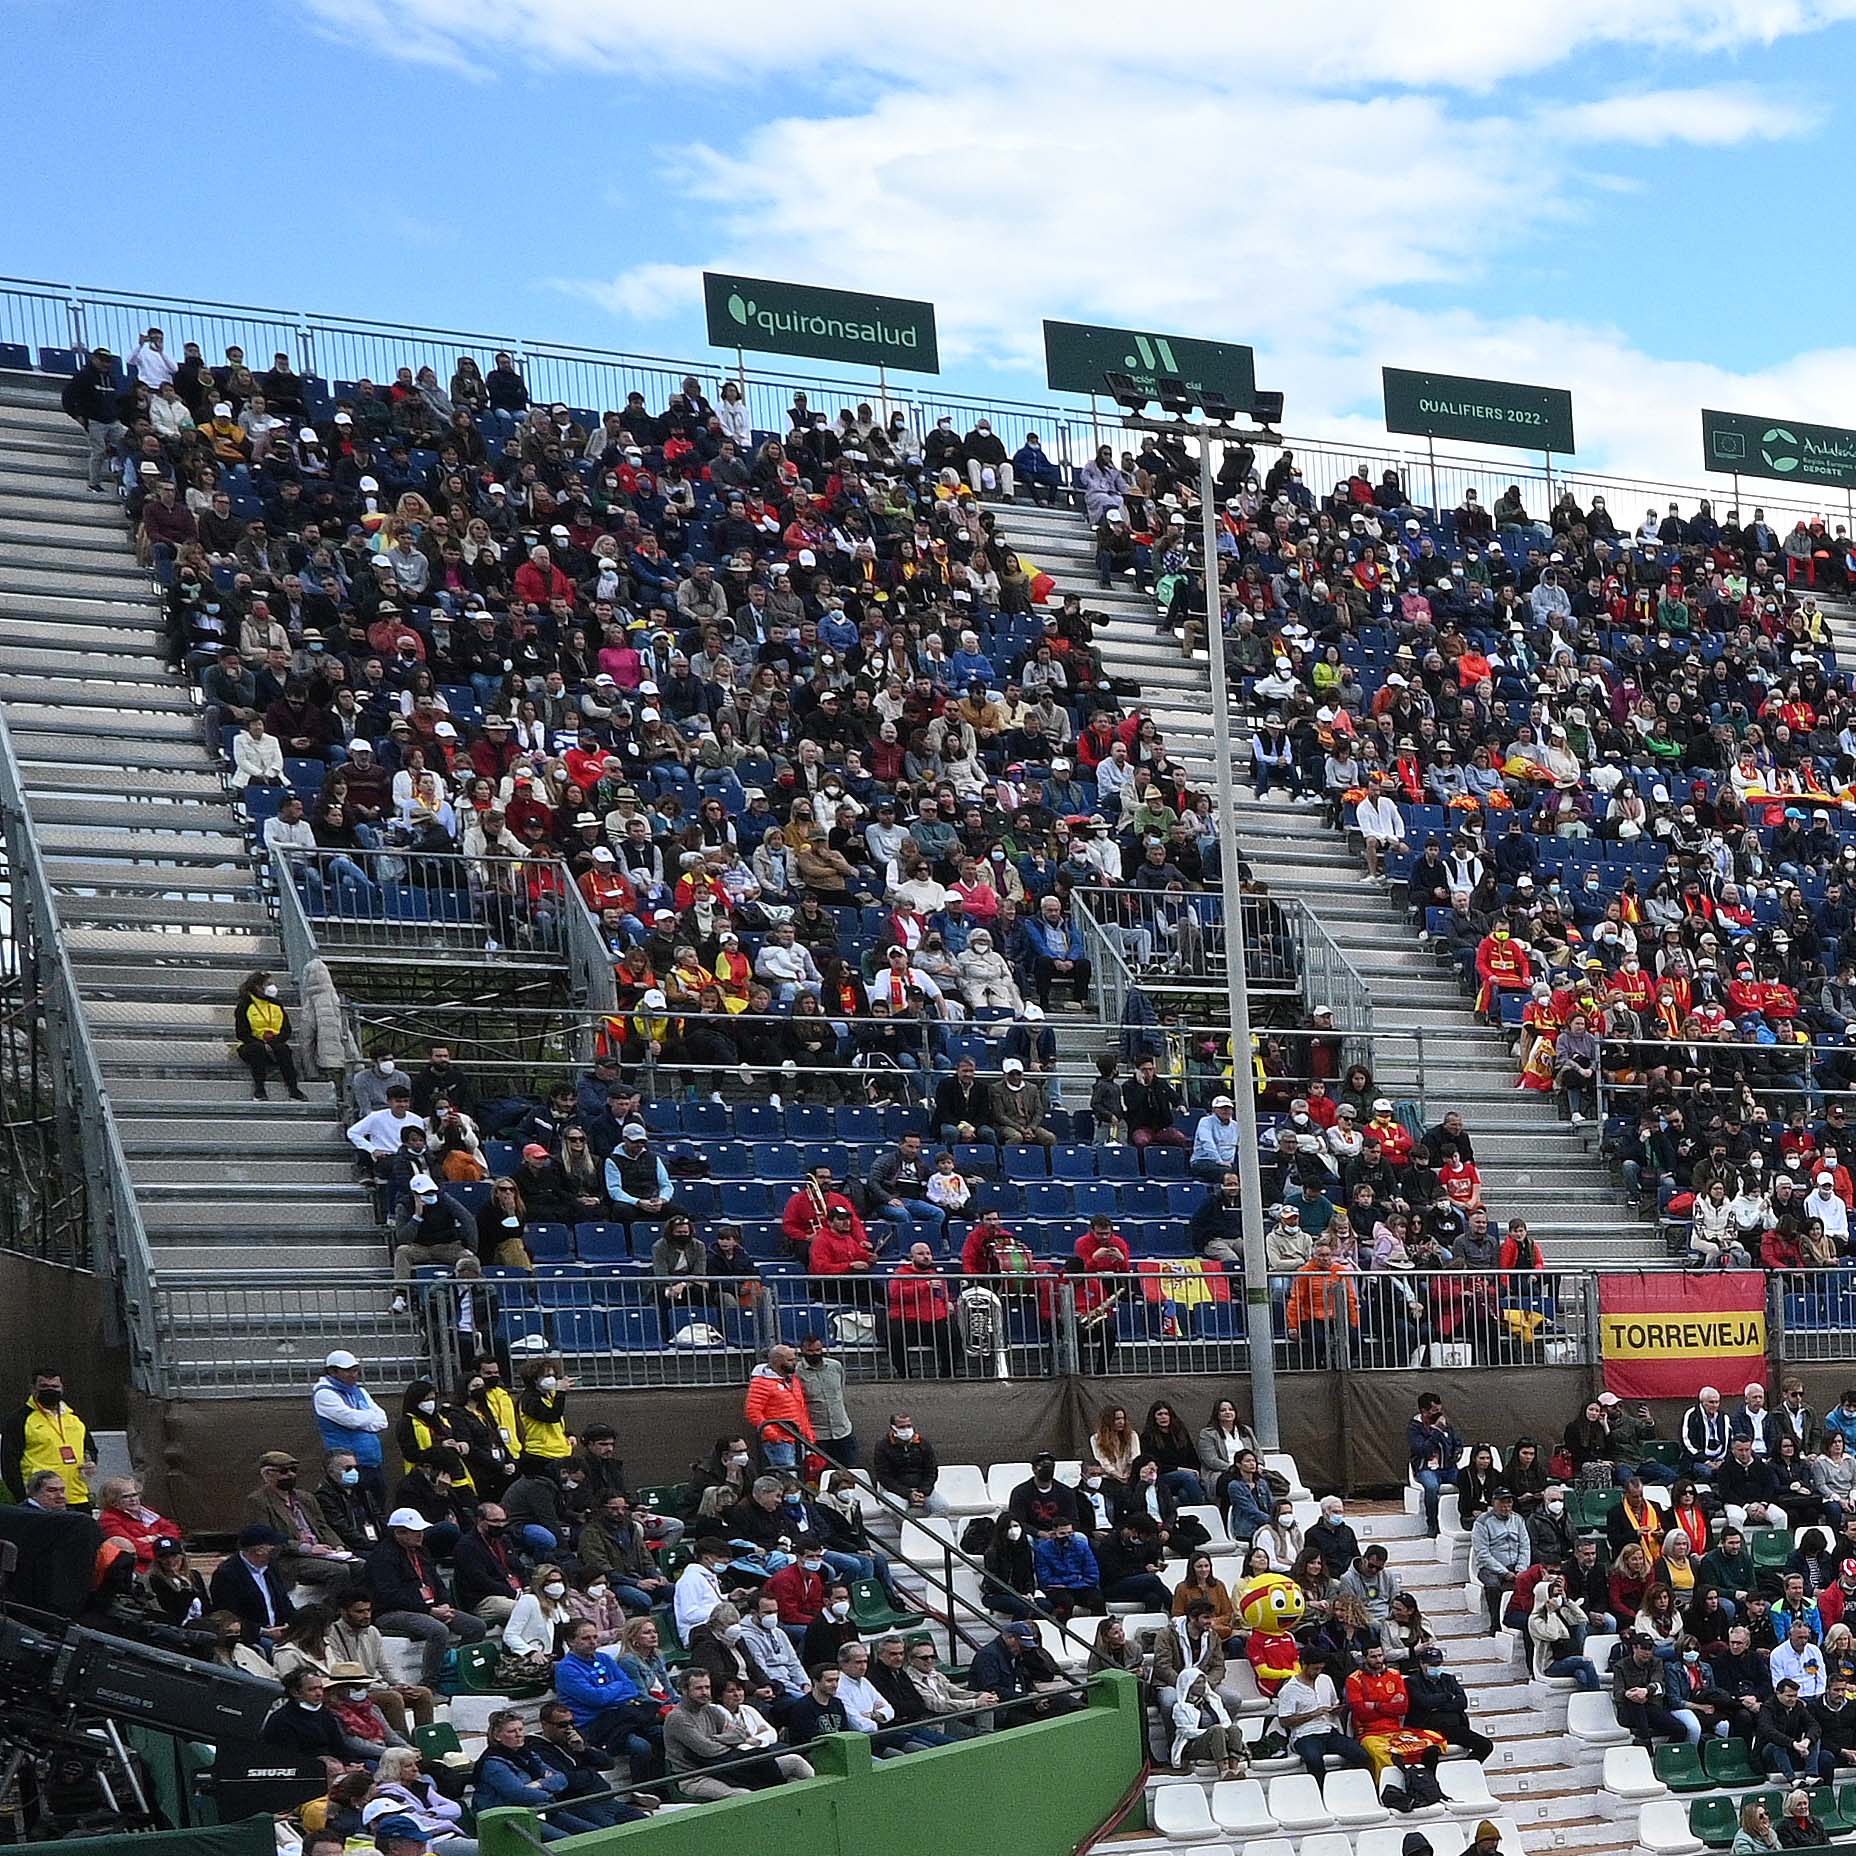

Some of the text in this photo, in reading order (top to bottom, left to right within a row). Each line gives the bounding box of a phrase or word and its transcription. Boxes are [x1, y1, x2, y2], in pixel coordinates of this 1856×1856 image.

[1419, 399, 1541, 425] QUALIFIERS 2022
[1803, 465, 1843, 477] DEPORTE
[1610, 1322, 1760, 1349] TORREVIEJA
[247, 1768, 297, 1778] SHURE
